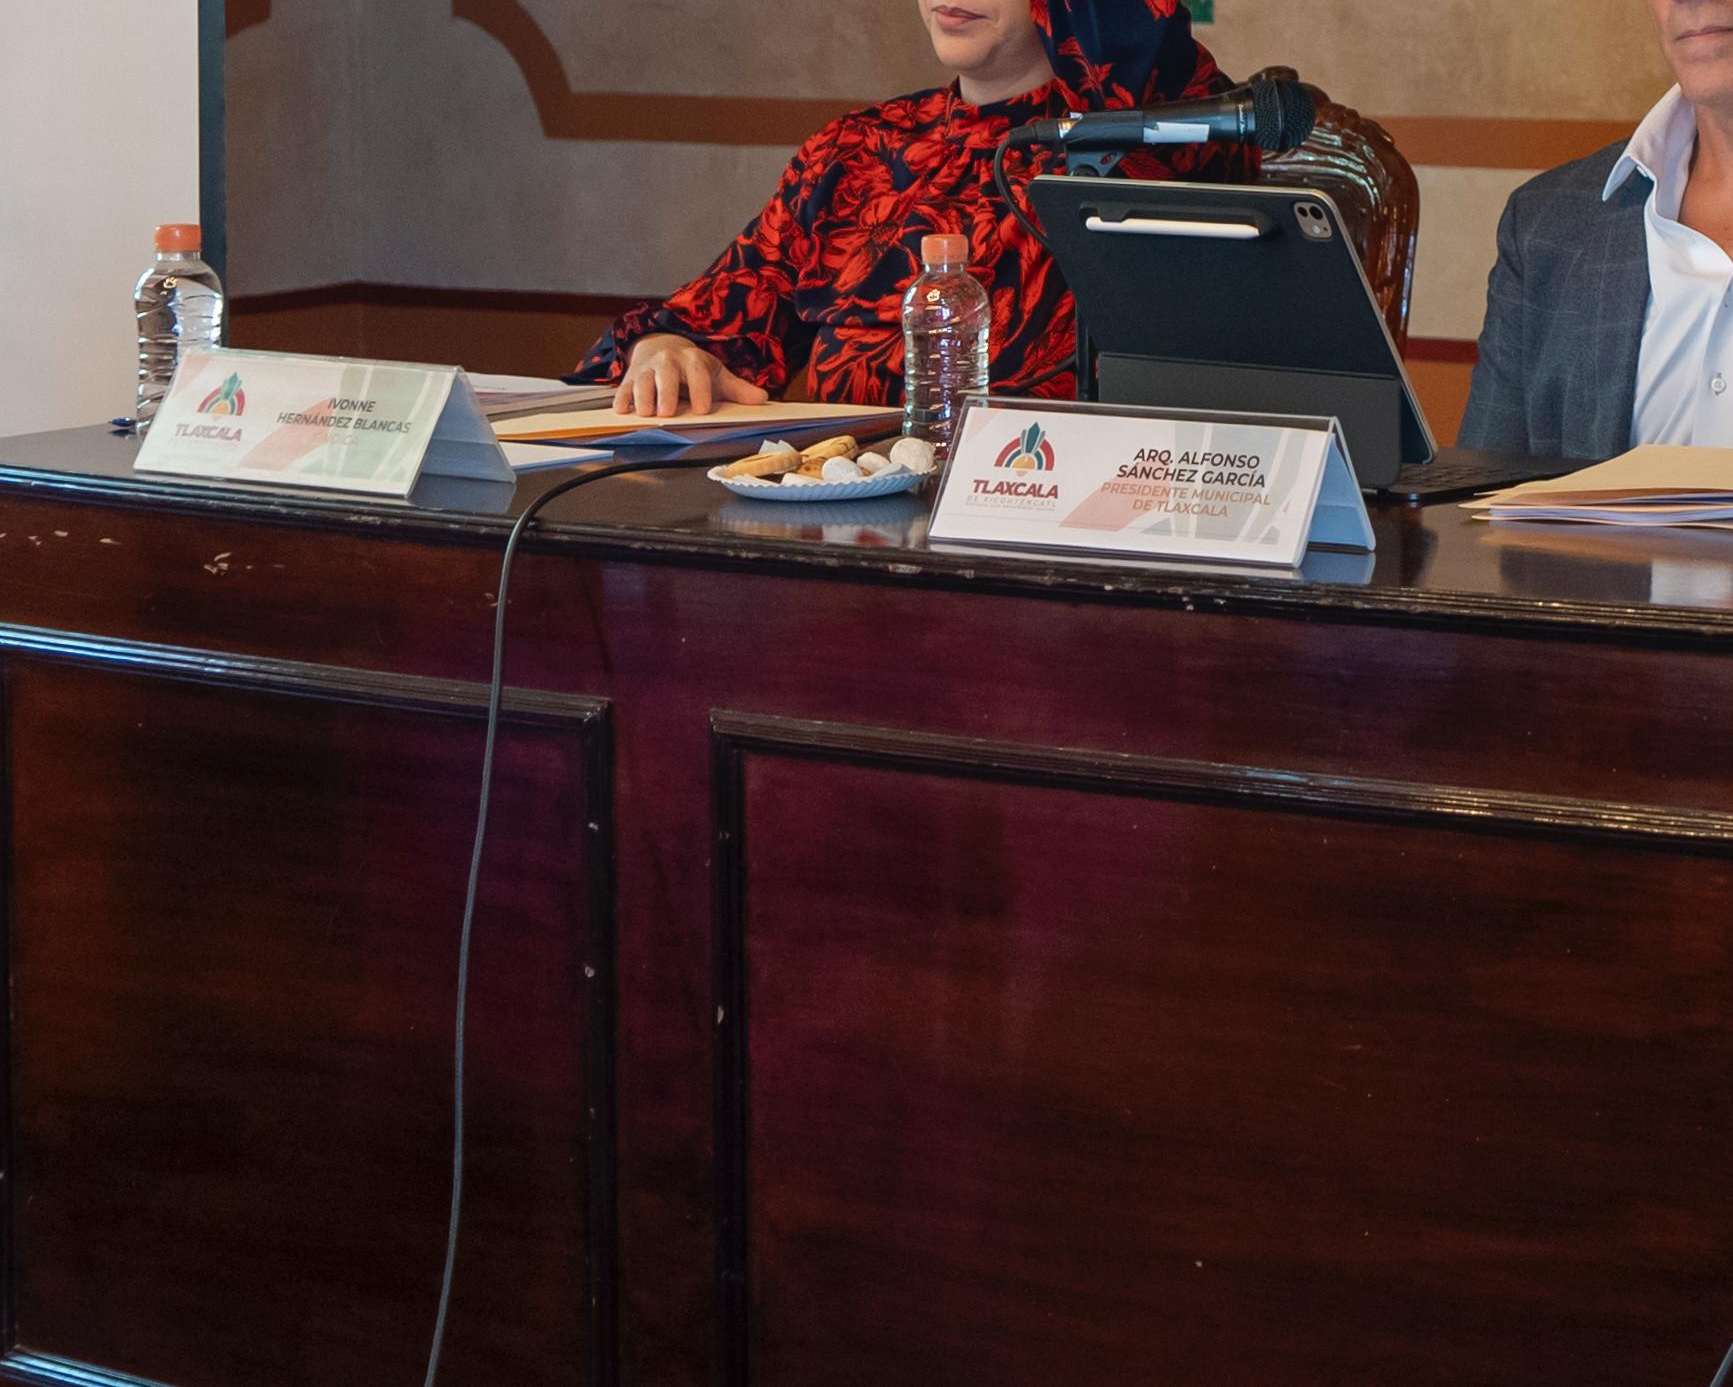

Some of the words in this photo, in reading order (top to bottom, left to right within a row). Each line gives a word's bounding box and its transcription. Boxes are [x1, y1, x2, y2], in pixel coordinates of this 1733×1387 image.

[328, 398, 376, 412] IVONNE
[175, 423, 242, 442] TLAXCALA
[277, 412, 352, 429] HERNÁNDEZ
[353, 418, 411, 433] BLANCAS
[1134, 448, 1174, 466] ARQ.
[1178, 451, 1260, 469] ALFONSO
[1117, 462, 1198, 483] SÁNCHEZ
[1201, 470, 1265, 488] GARCÍA
[973, 479, 1059, 499] TLAXCALA
[1101, 482, 1189, 499] PRESIDENTE
[1192, 489, 1271, 506] MUNICIPAL
[1132, 499, 1155, 511] DE
[1157, 501, 1228, 518] TLAXCALA
